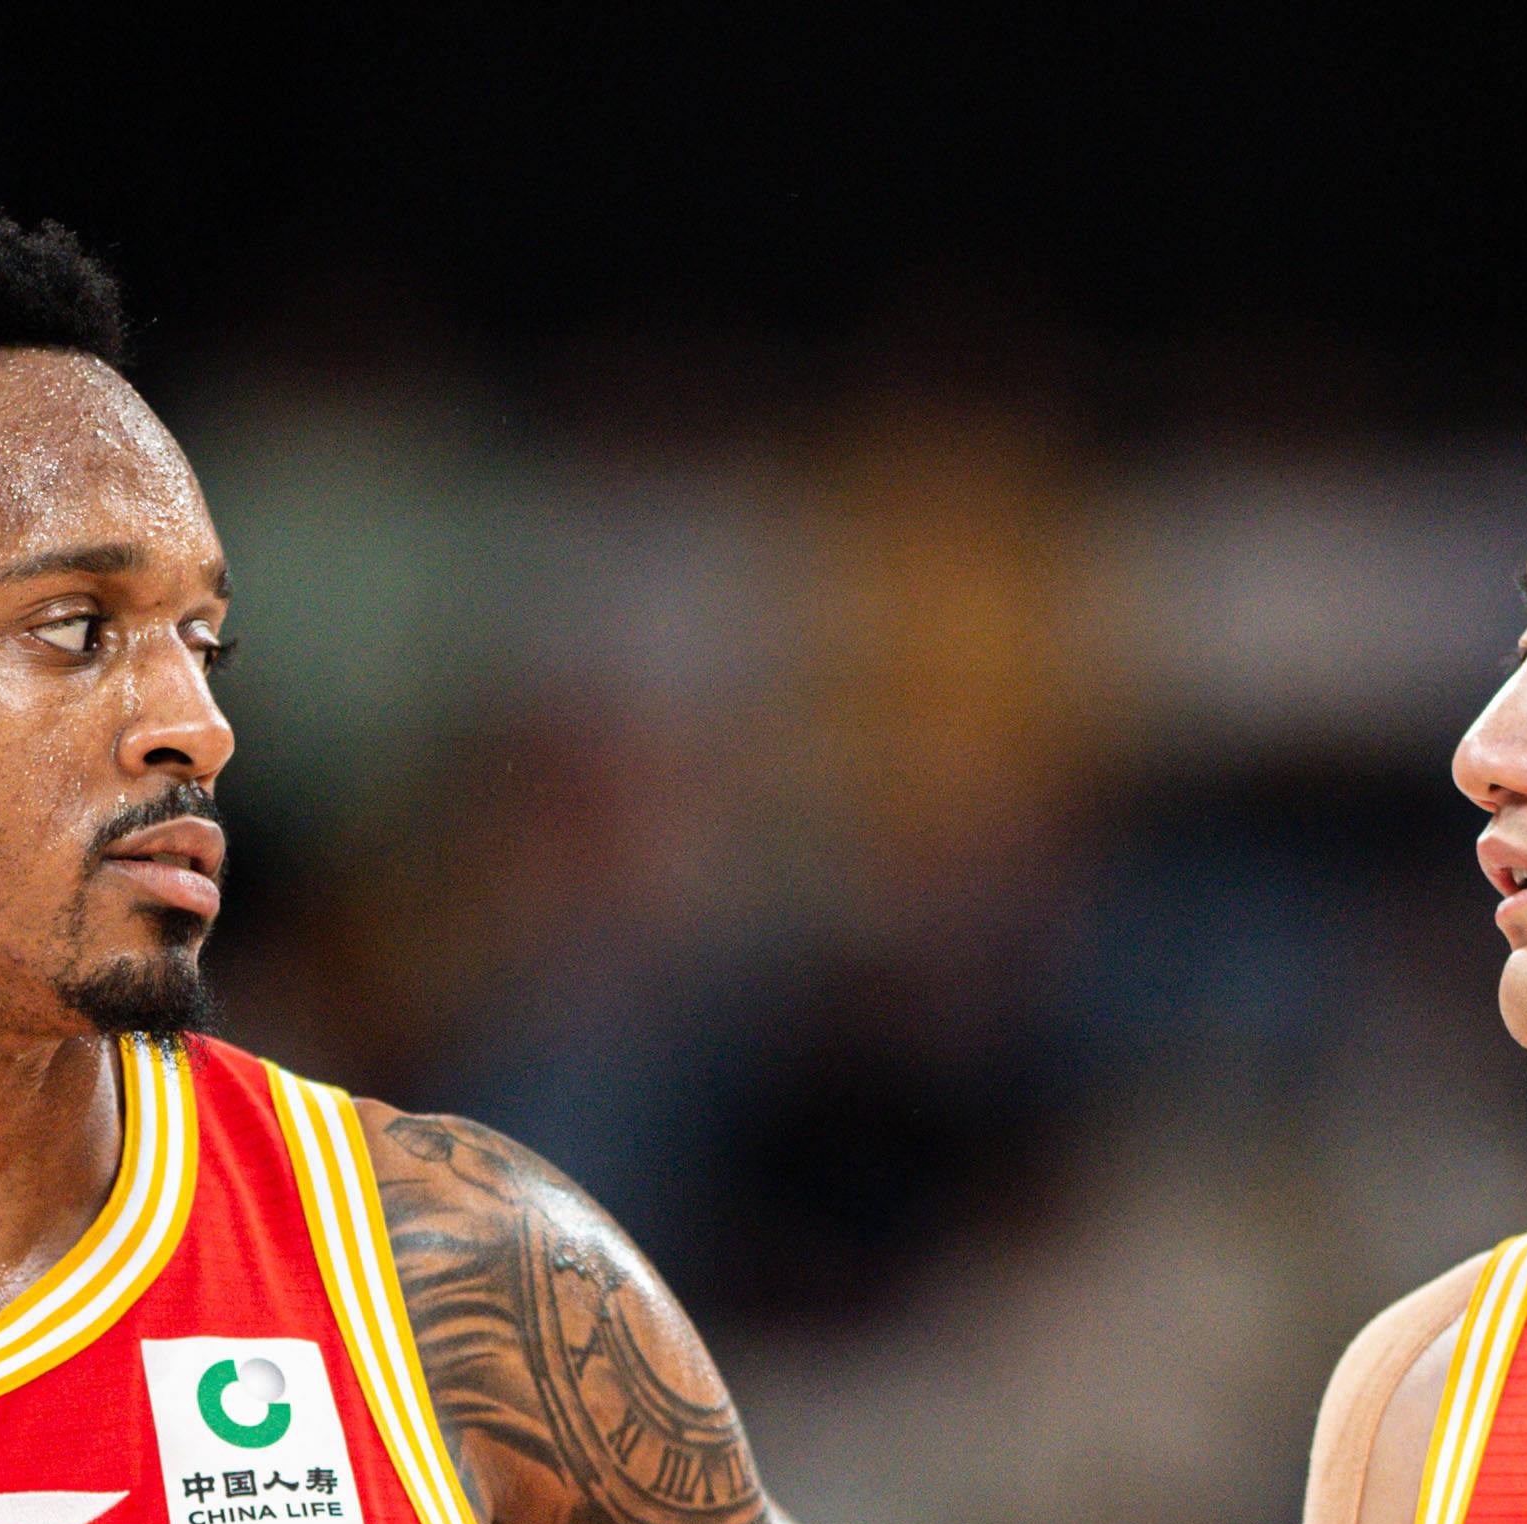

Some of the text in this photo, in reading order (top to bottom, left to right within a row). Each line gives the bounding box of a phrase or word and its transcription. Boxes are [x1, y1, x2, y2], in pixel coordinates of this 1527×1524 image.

[182, 1467, 337, 1504] 中国人寿
[286, 1501, 343, 1518] LIFE
